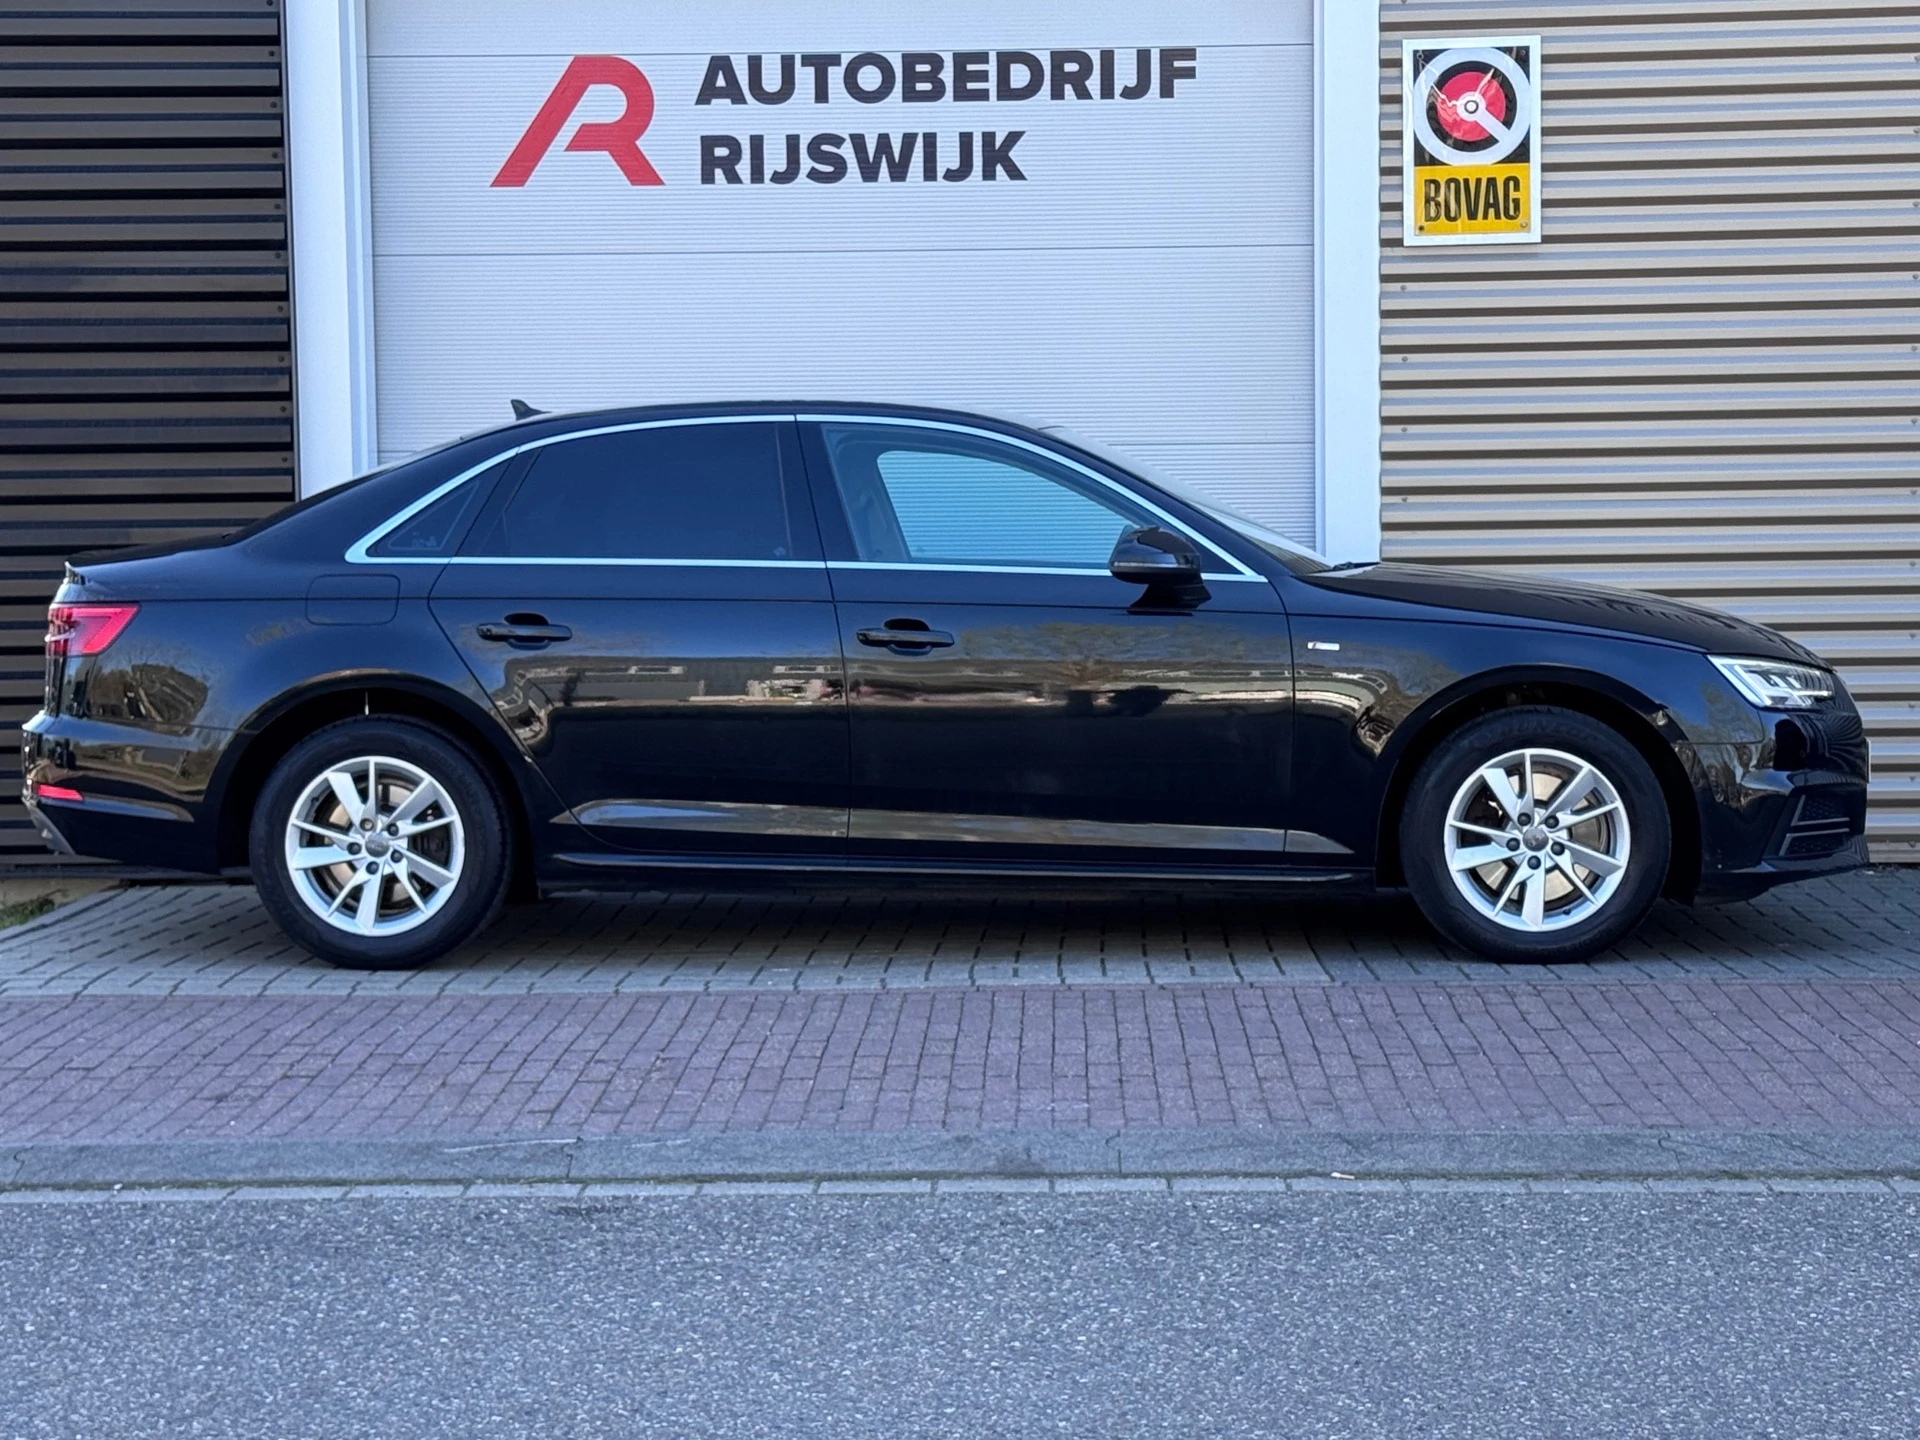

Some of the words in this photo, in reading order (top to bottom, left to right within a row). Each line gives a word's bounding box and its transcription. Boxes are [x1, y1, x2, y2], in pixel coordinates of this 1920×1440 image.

[695, 48, 1197, 105] AUTOBEDRIJF
[699, 131, 1028, 185] RIJSWIJK
[1424, 175, 1521, 222] BOVAG
